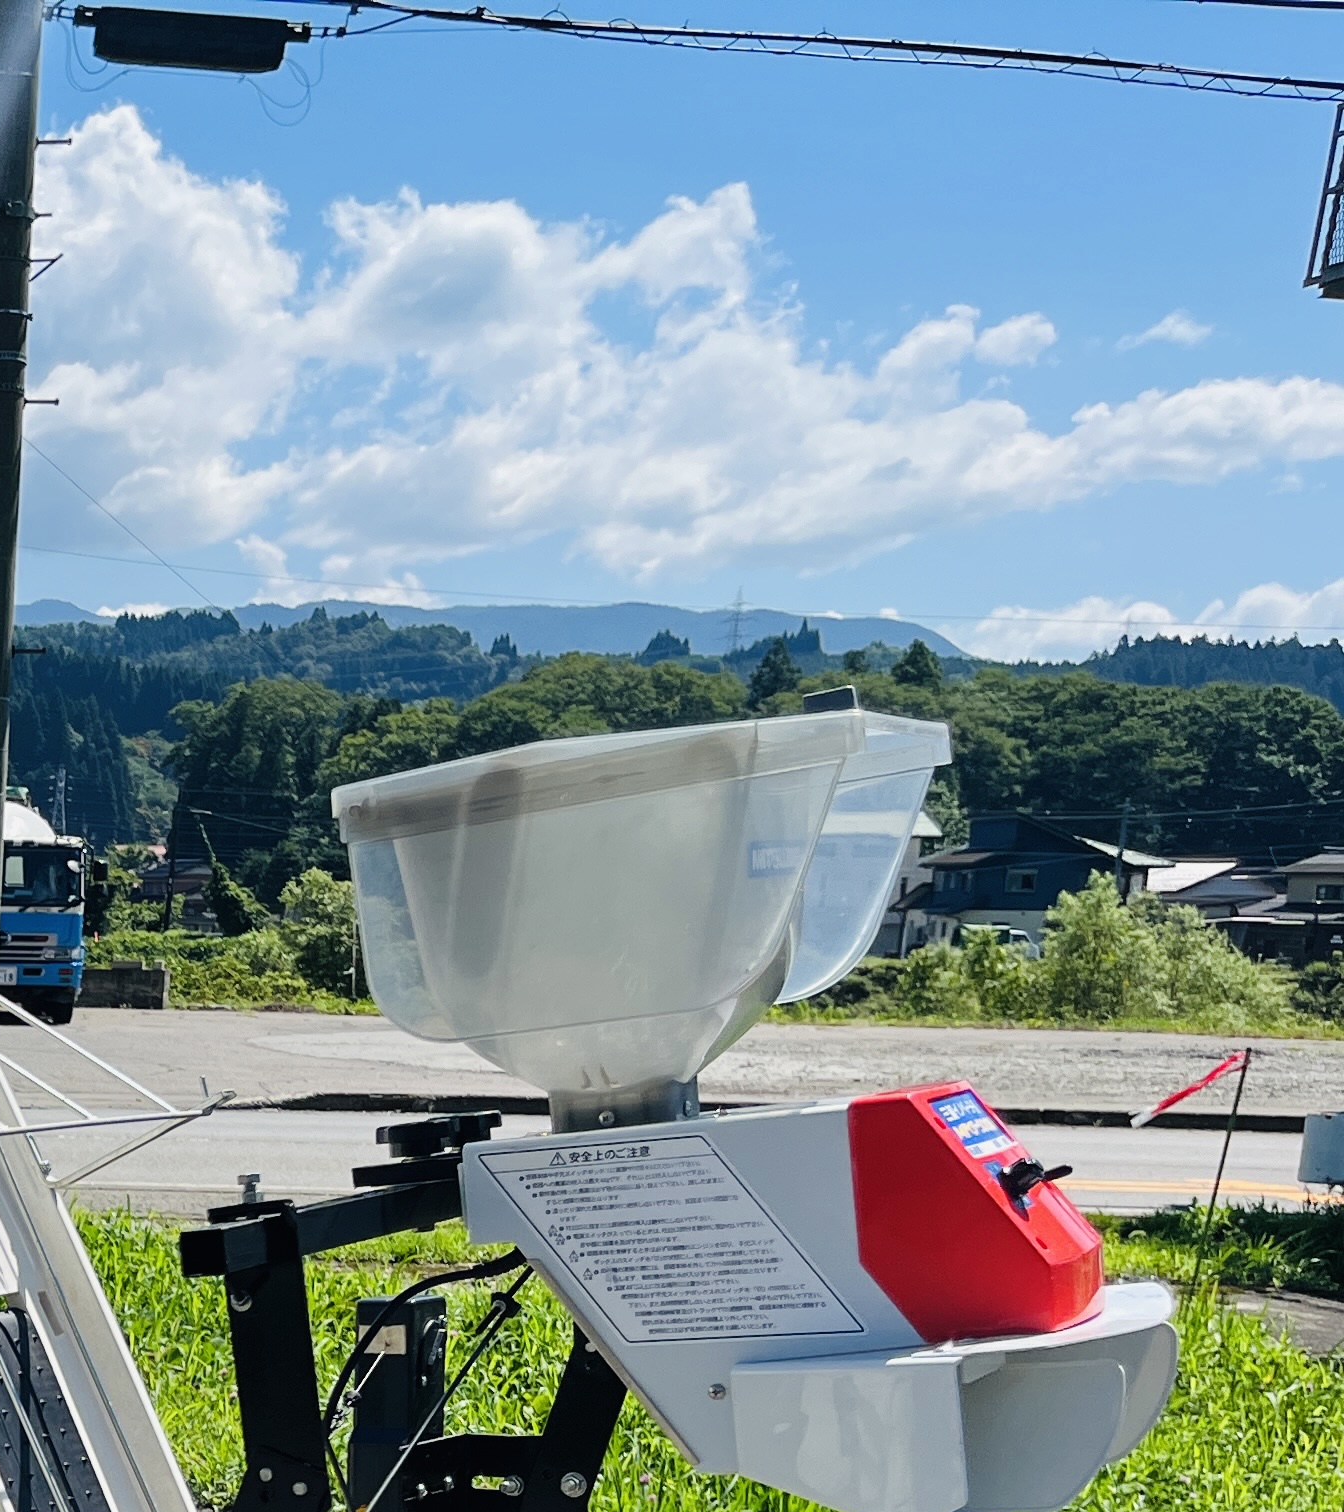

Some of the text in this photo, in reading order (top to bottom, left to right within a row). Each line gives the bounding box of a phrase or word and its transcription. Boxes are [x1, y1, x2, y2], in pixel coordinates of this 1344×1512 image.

[568, 1145, 651, 1164] 安全上のご注意
